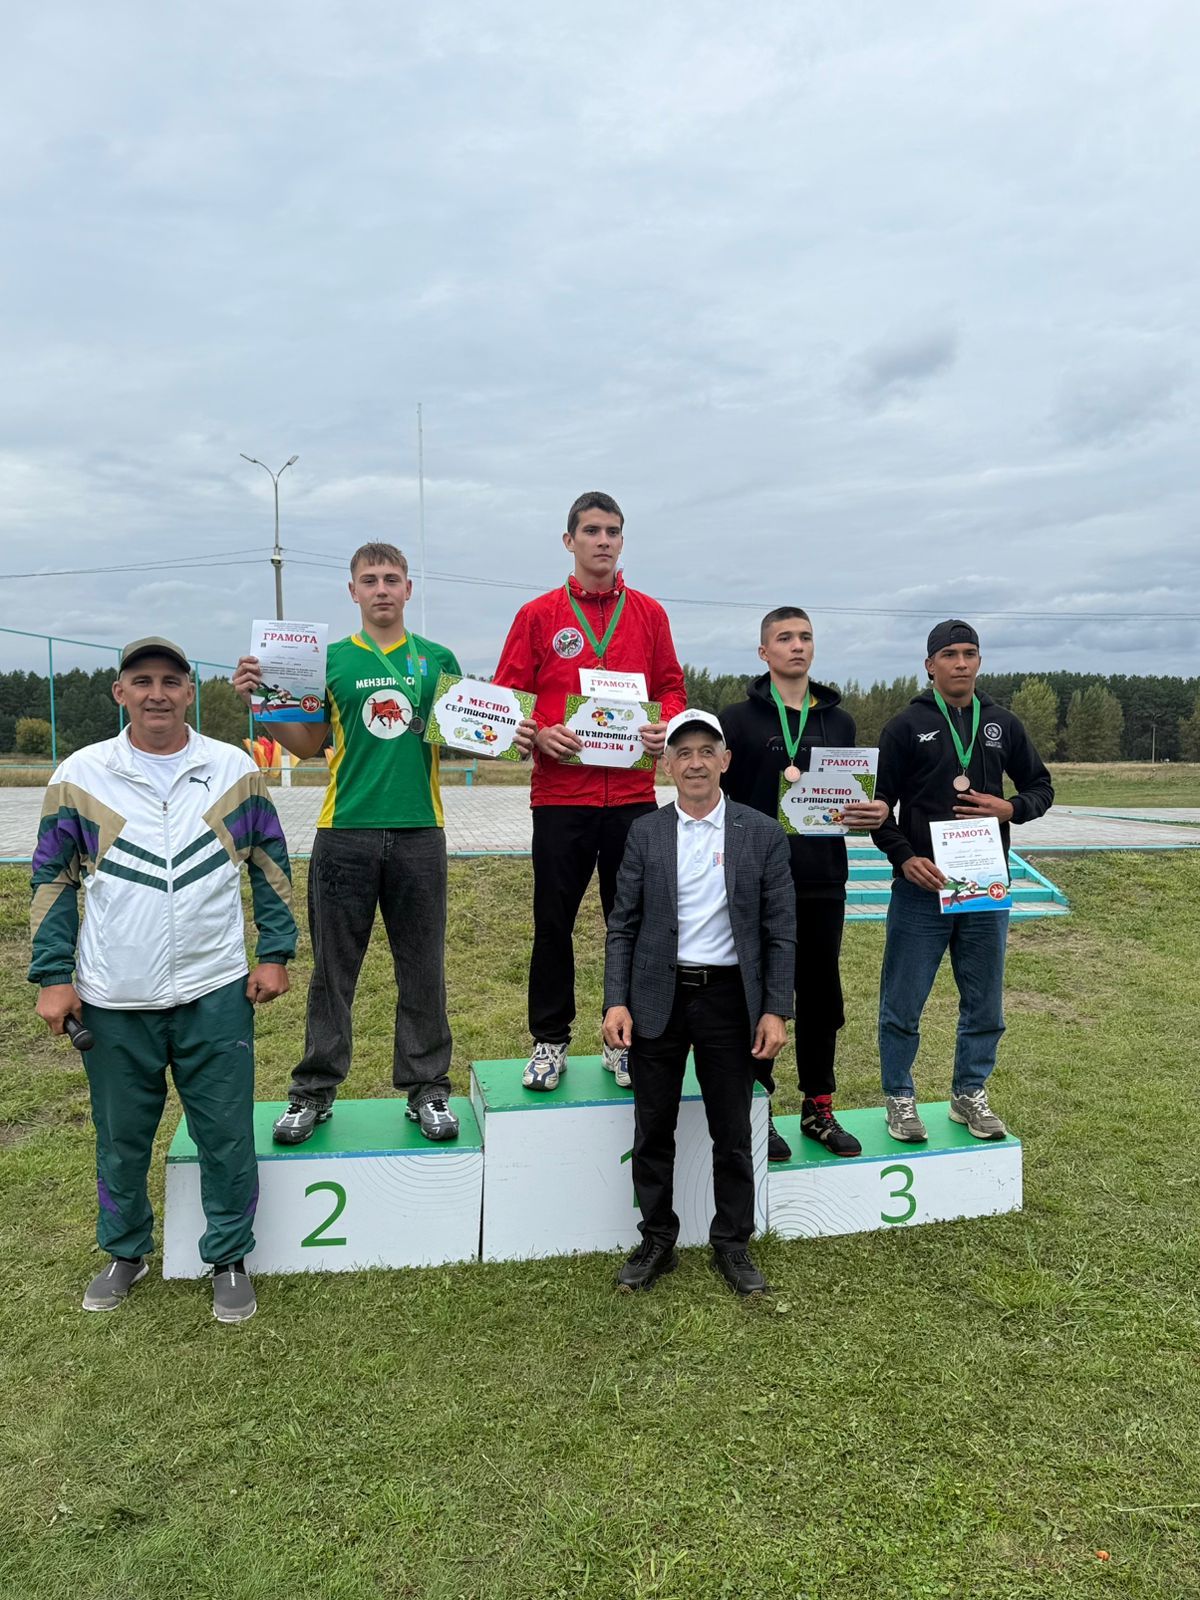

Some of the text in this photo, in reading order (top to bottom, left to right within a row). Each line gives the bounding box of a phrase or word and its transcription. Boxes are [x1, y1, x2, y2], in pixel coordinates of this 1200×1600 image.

[263, 632, 318, 644] ГРАМОТА
[356, 676, 416, 689] МЕНЗЕЛИС
[591, 679, 638, 689] ГРАМОТА
[457, 695, 510, 714] 2 МЕСТО
[445, 703, 517, 726] СЕРТИФИКАТ
[584, 740, 624, 751] МЕСТО
[821, 758, 869, 767] ГРАМОТА
[812, 787, 852, 796] МЕСТО
[790, 796, 861, 805] СЕРТИФИКАТ
[942, 828, 992, 840] ГРАМОТА
[880, 1164, 917, 1224] 3
[300, 1180, 347, 1248] 2
